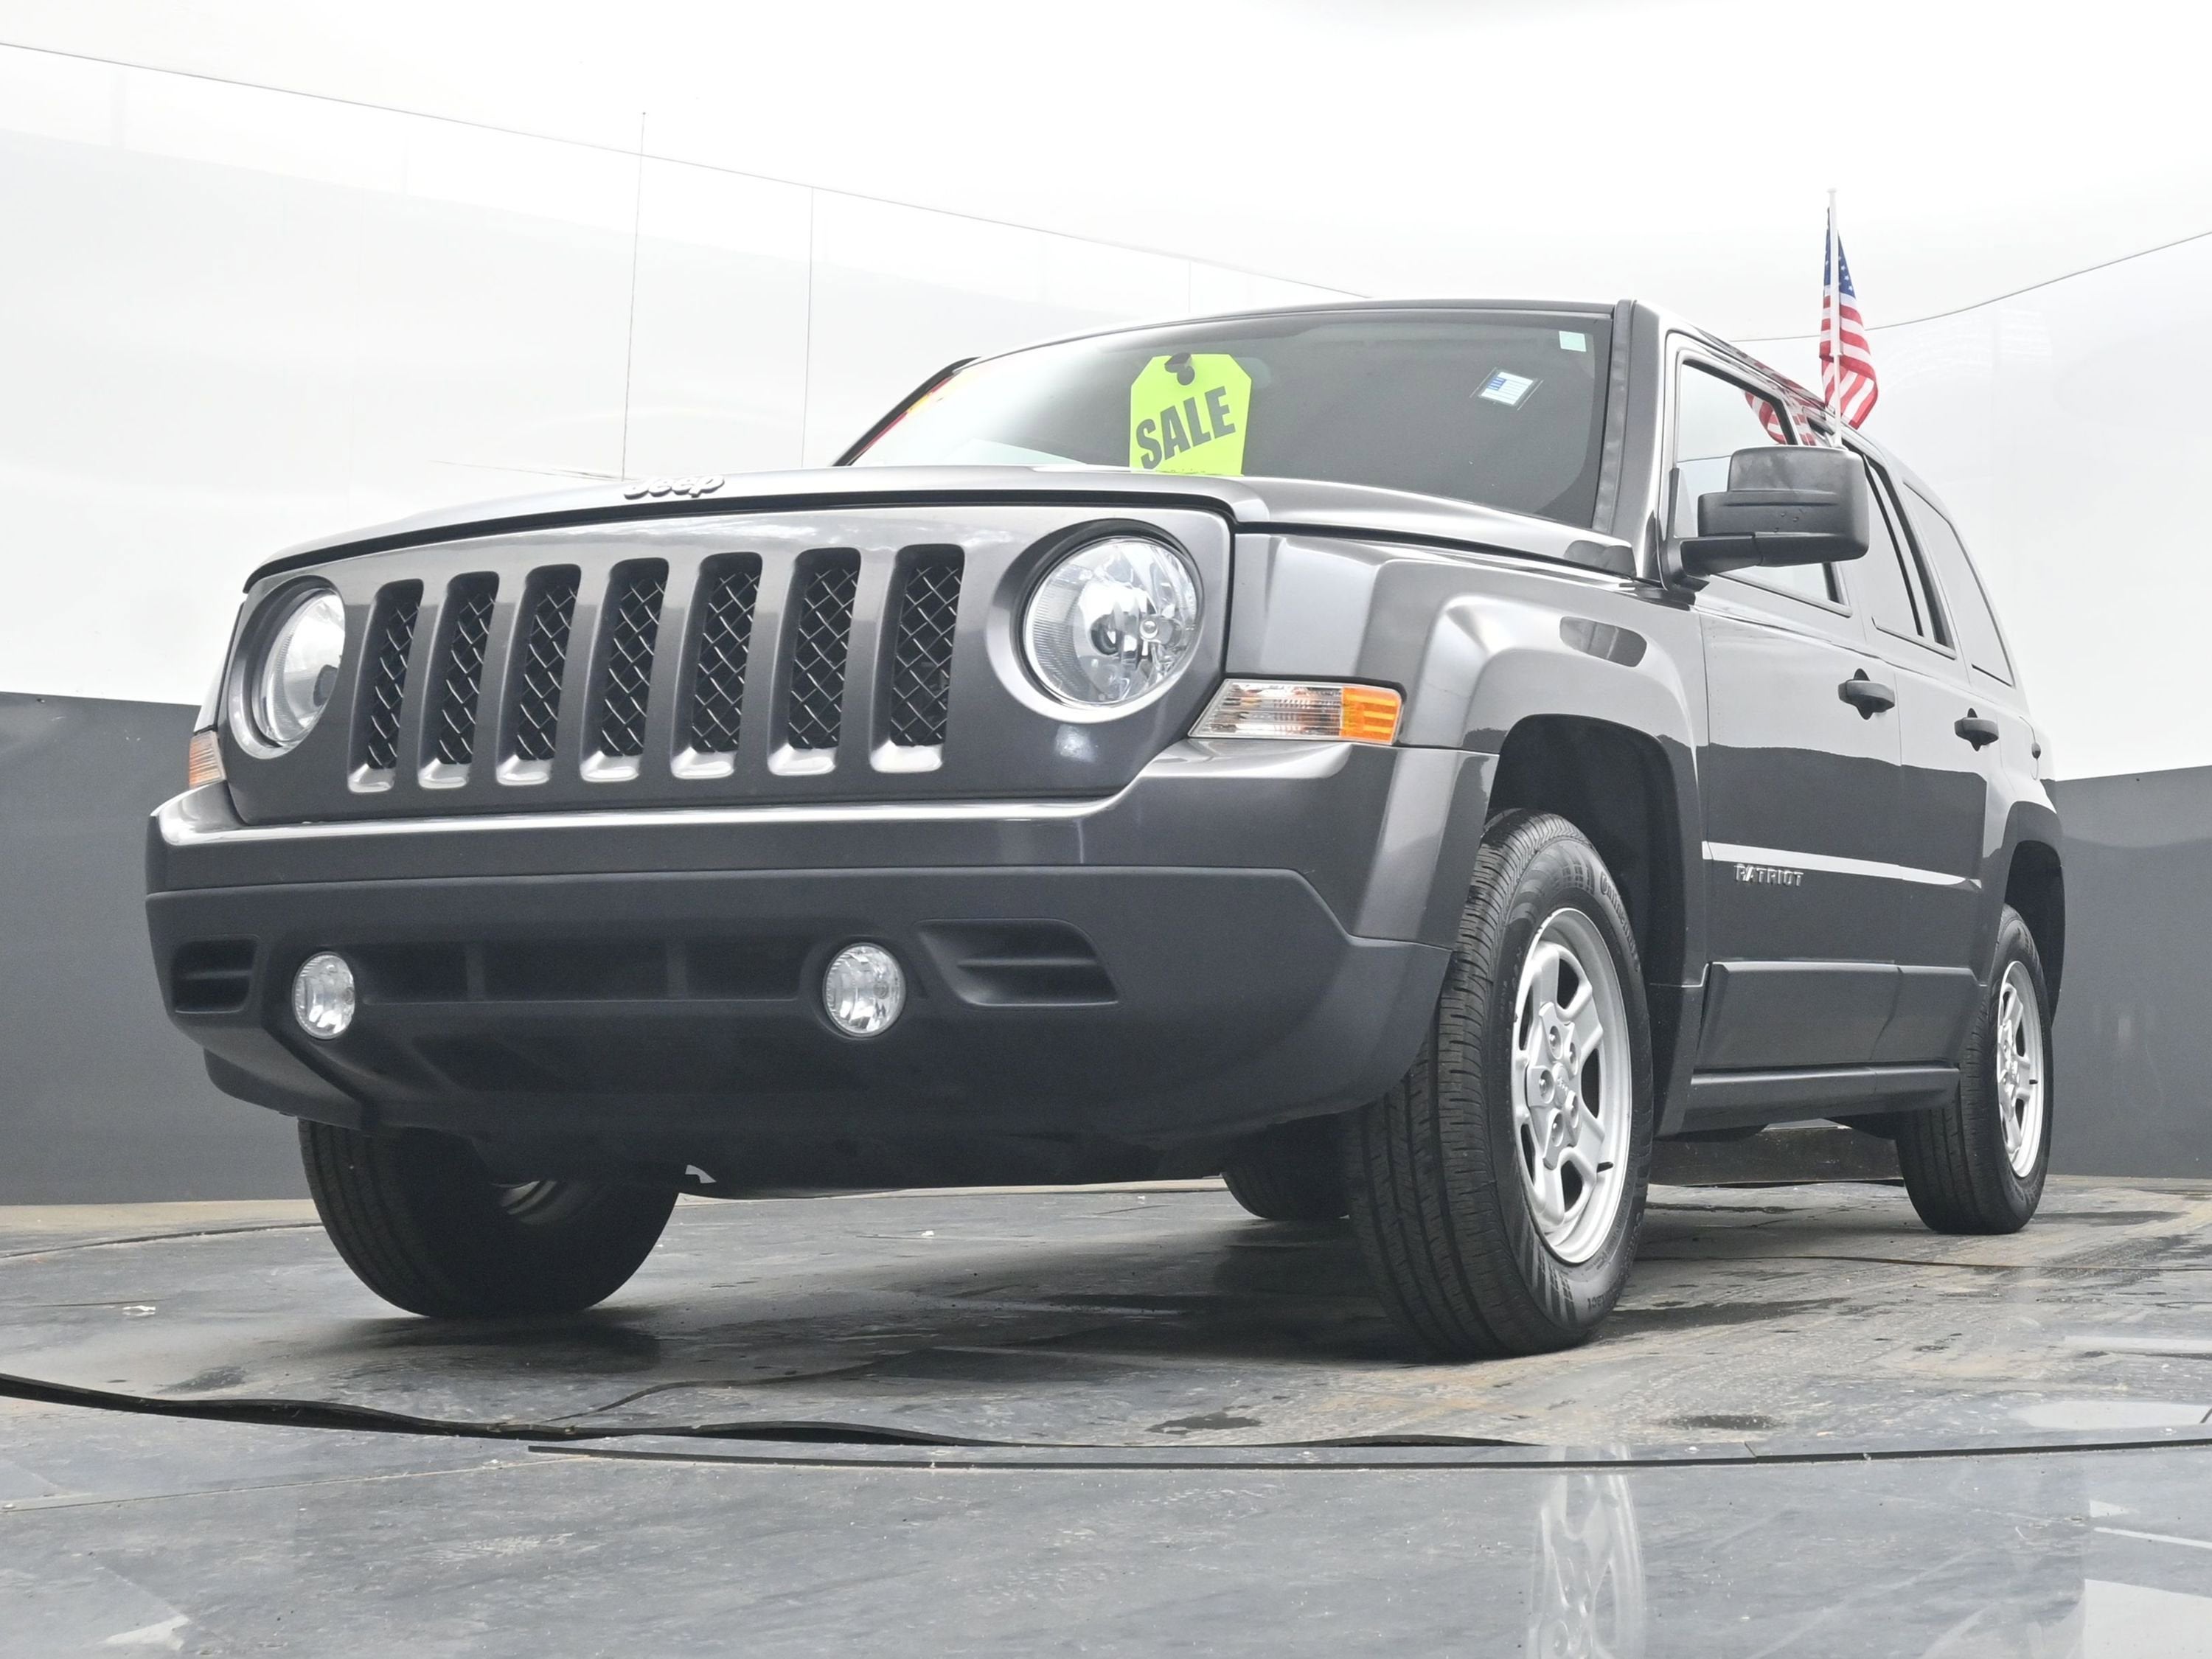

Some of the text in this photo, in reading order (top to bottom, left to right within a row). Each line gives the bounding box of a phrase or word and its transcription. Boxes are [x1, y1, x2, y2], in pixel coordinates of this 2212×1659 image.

[1136, 386, 1236, 470] SALE
[624, 476, 725, 499] Jeep
[1733, 863, 1804, 886] PATRIOT
